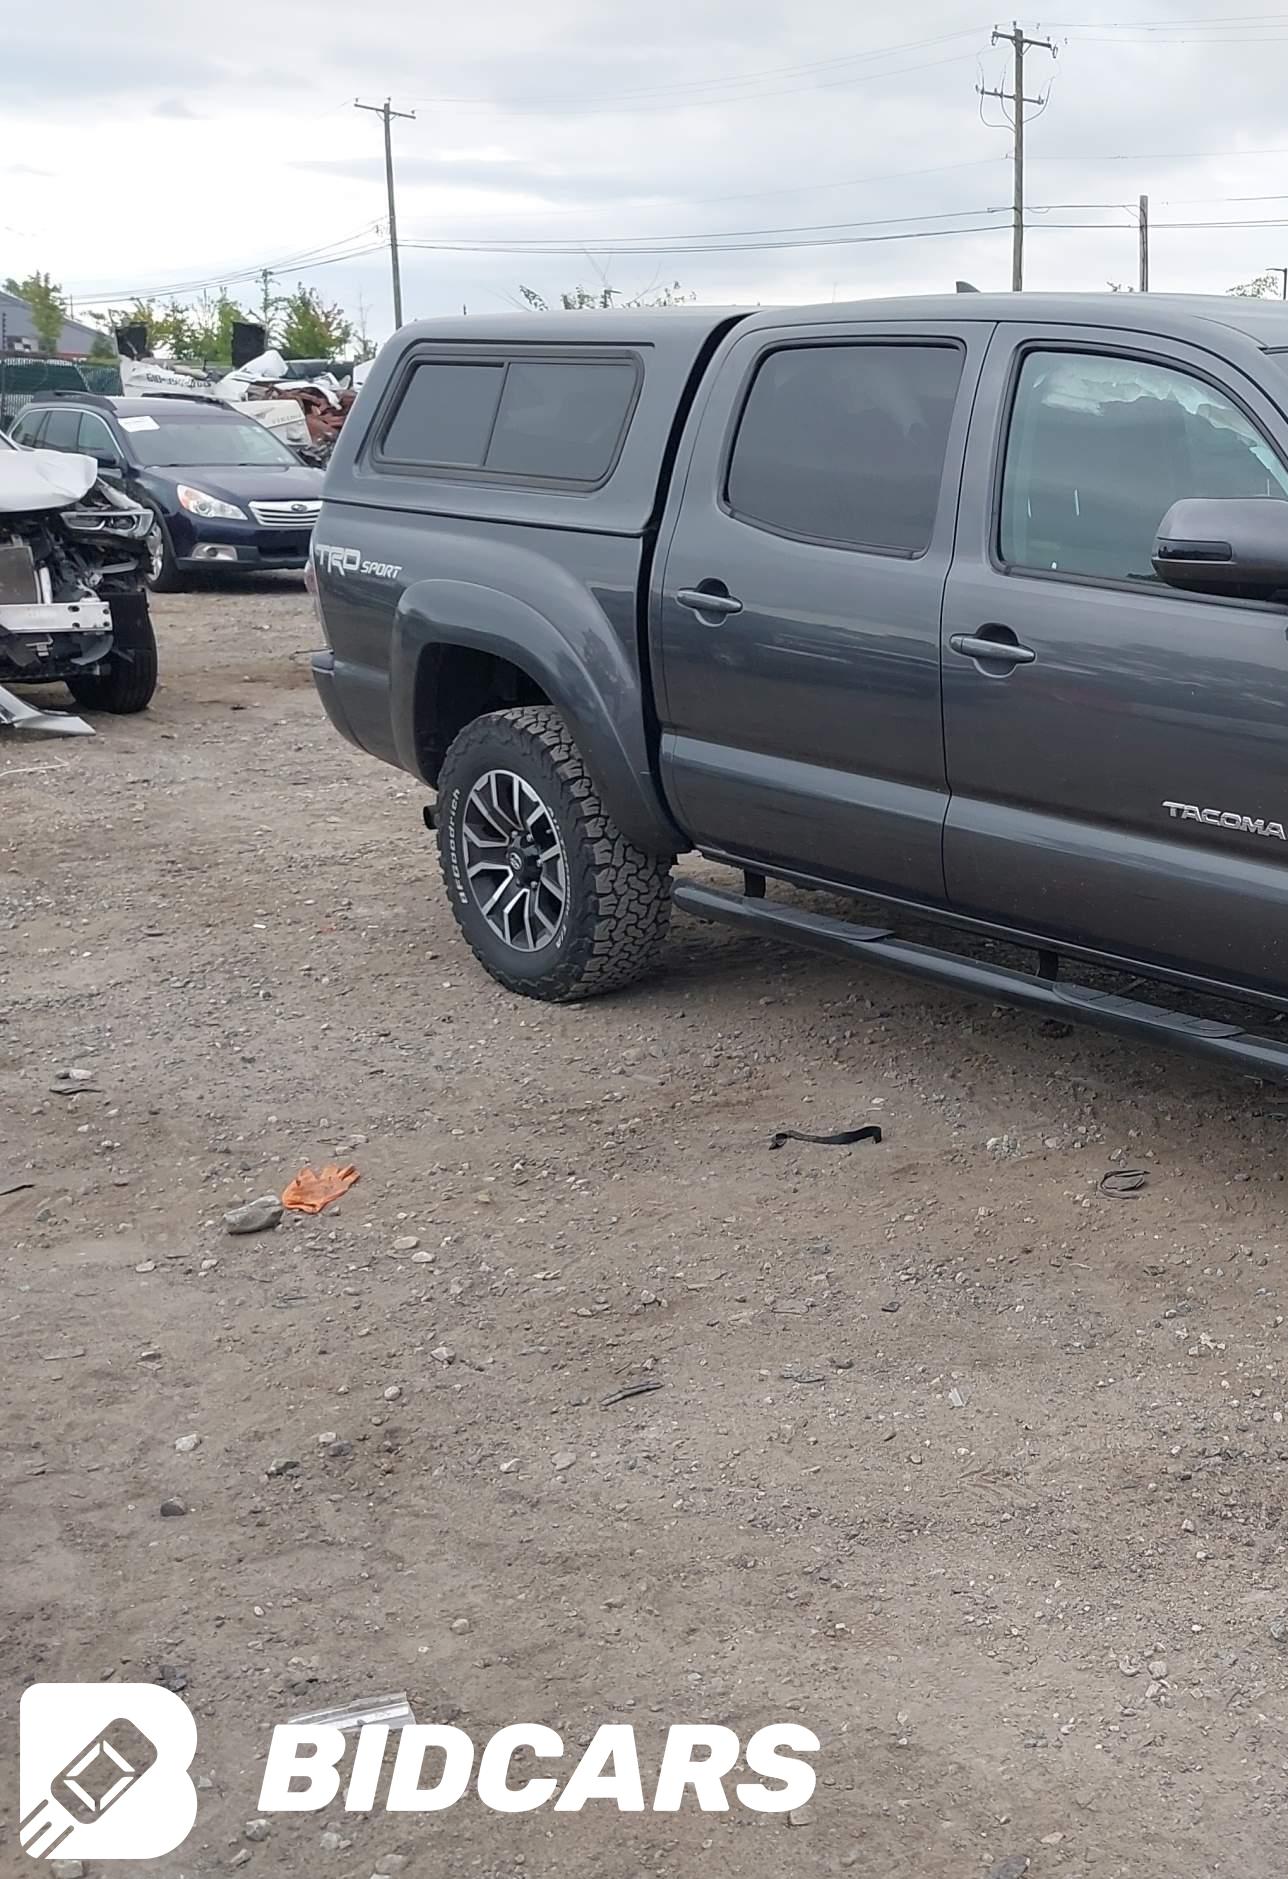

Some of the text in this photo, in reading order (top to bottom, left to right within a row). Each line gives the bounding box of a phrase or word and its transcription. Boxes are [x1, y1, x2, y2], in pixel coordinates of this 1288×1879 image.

[315, 543, 404, 580] TRD SPORT
[1162, 800, 1288, 841] TACOMA
